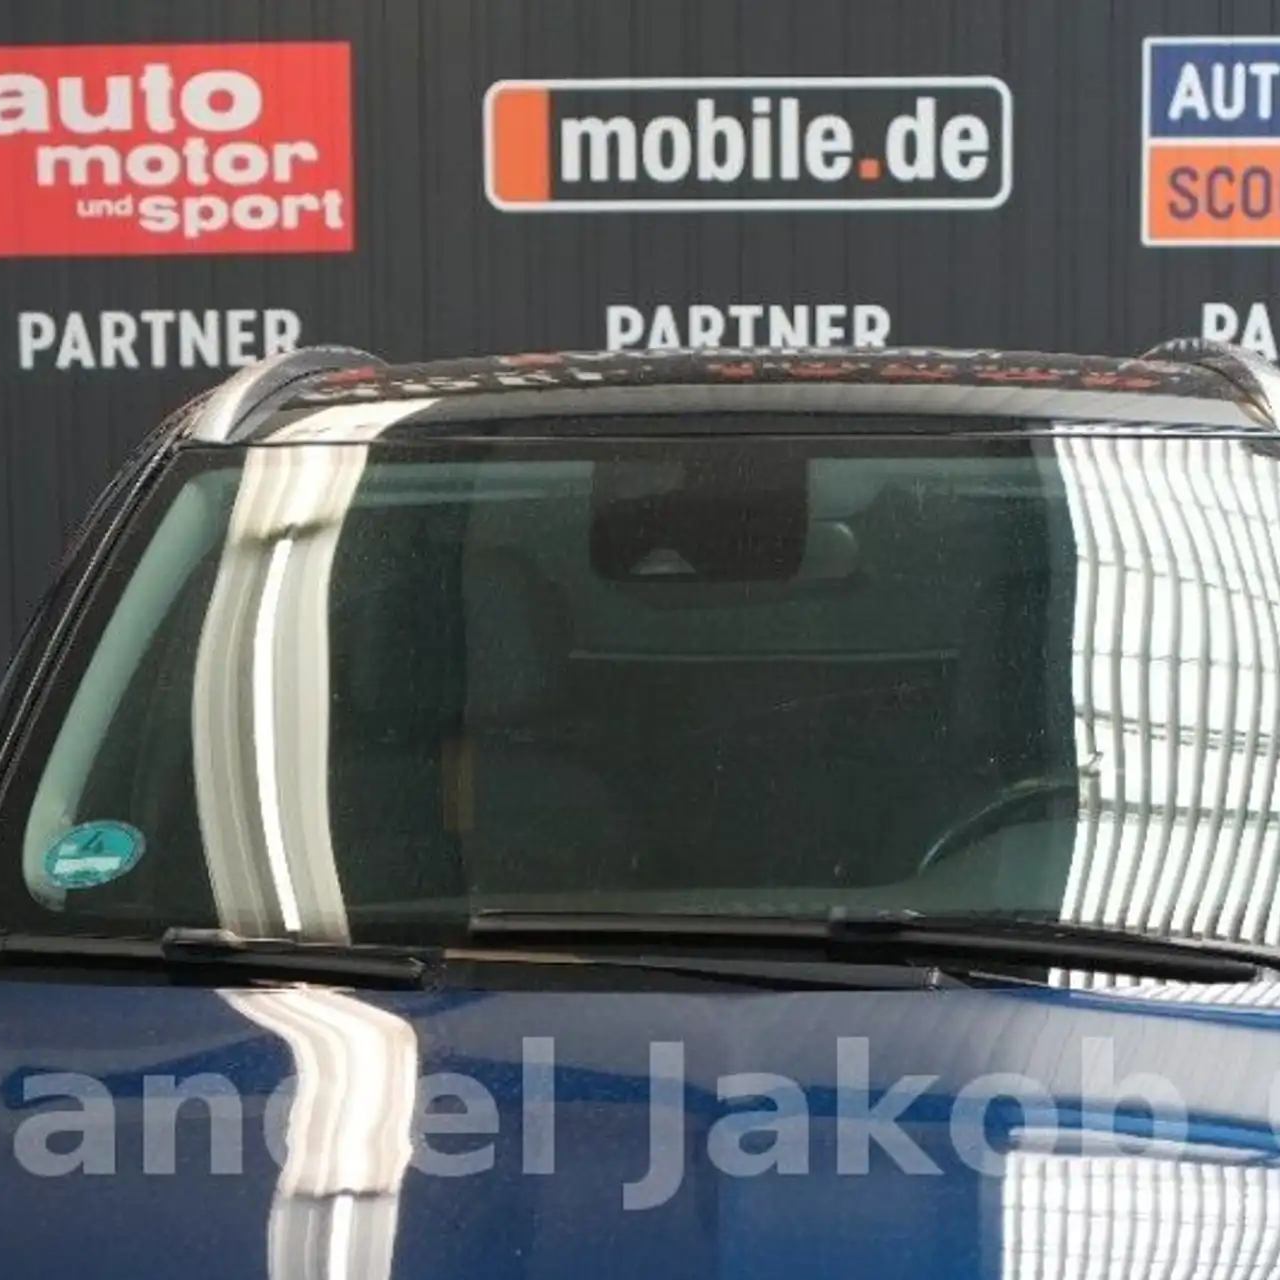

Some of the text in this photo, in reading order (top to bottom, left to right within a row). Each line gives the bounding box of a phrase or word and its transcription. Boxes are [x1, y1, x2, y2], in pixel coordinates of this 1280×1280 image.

[34, 138, 318, 186] motor
[560, 97, 990, 182] mobile.de
[76, 188, 343, 238] und sport
[18, 309, 302, 369] PARTNER
[606, 304, 892, 350] PARTNER
